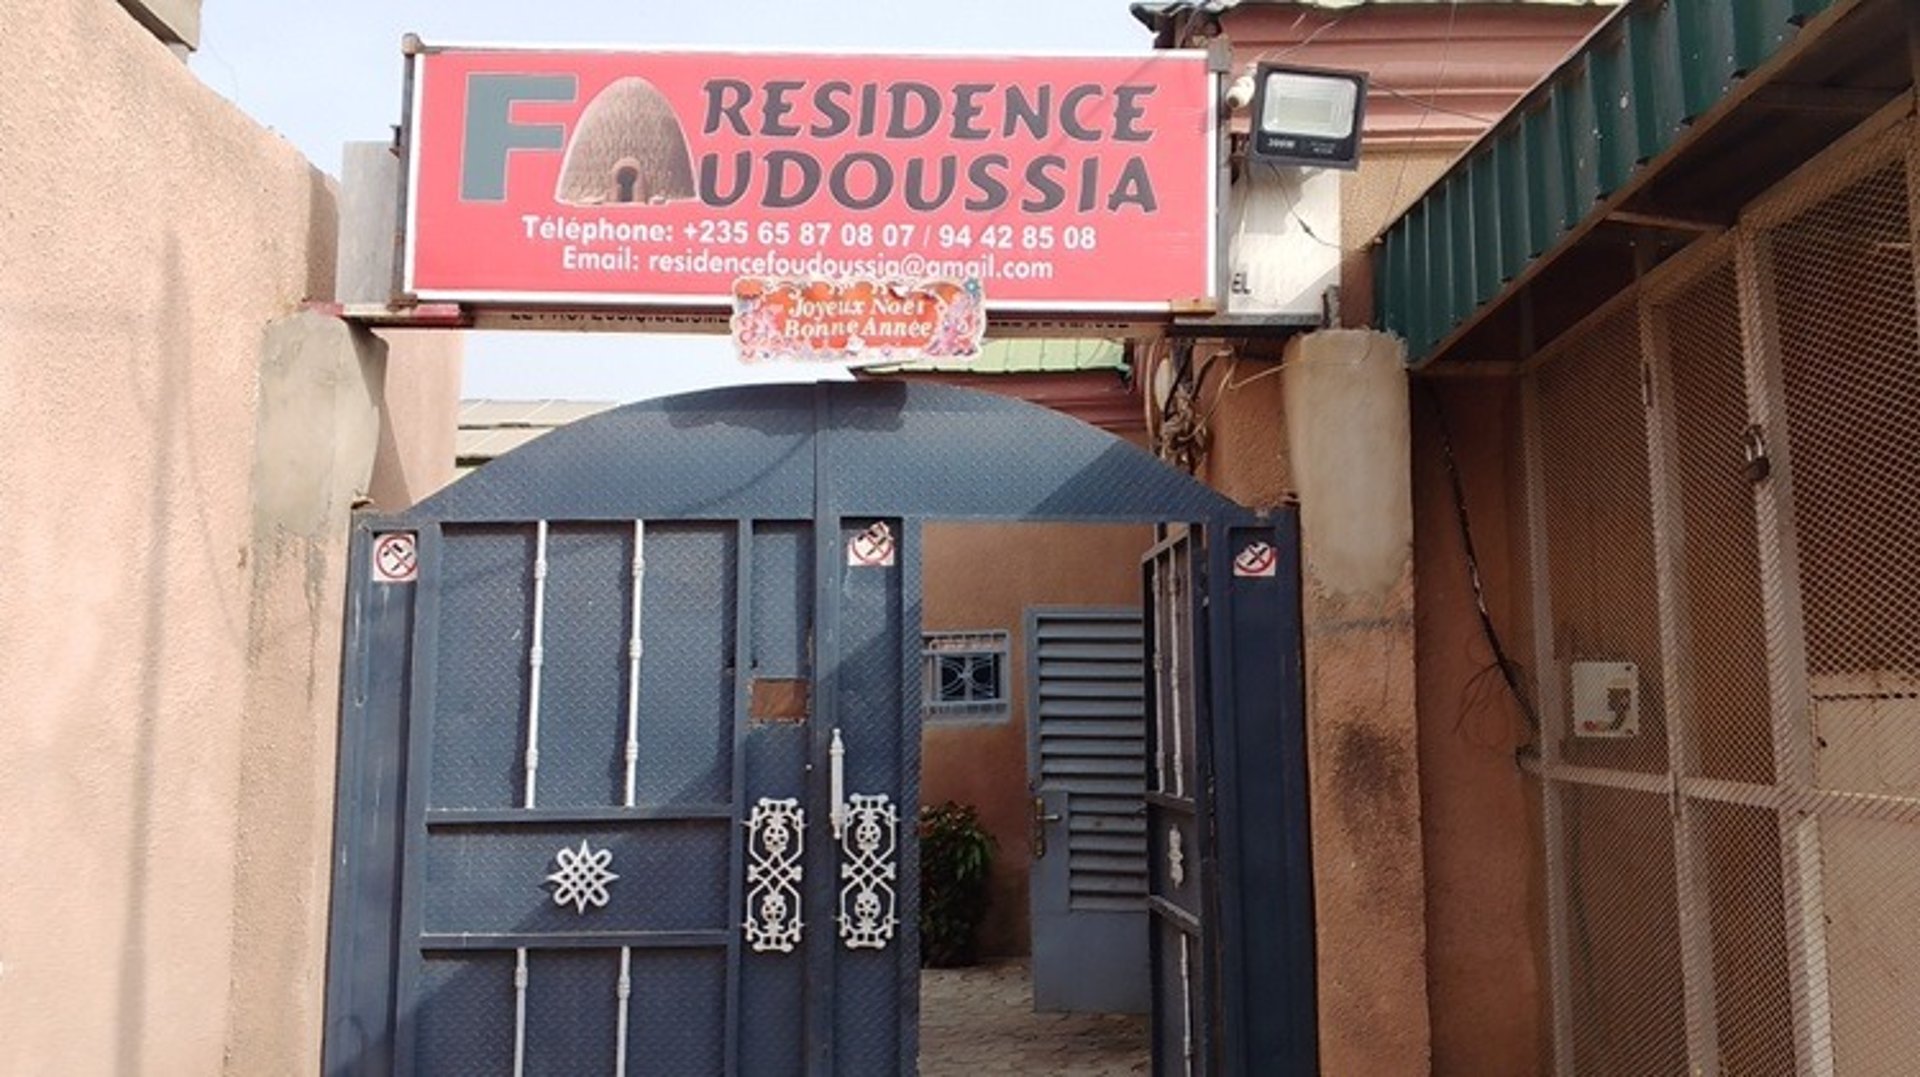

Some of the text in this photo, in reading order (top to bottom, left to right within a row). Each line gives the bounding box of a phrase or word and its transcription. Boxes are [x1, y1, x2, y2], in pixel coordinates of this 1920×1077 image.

[702, 79, 1157, 142] RESIDENCE
[461, 73, 578, 201] F
[699, 150, 1157, 214] UDOUSSIA
[521, 215, 1096, 250] Téléphone: +235 65 87 08 07 / 94 42 85 08
[562, 246, 639, 271] Email:
[788, 299, 866, 320] Joyeux
[784, 317, 932, 338] Bonne Année
